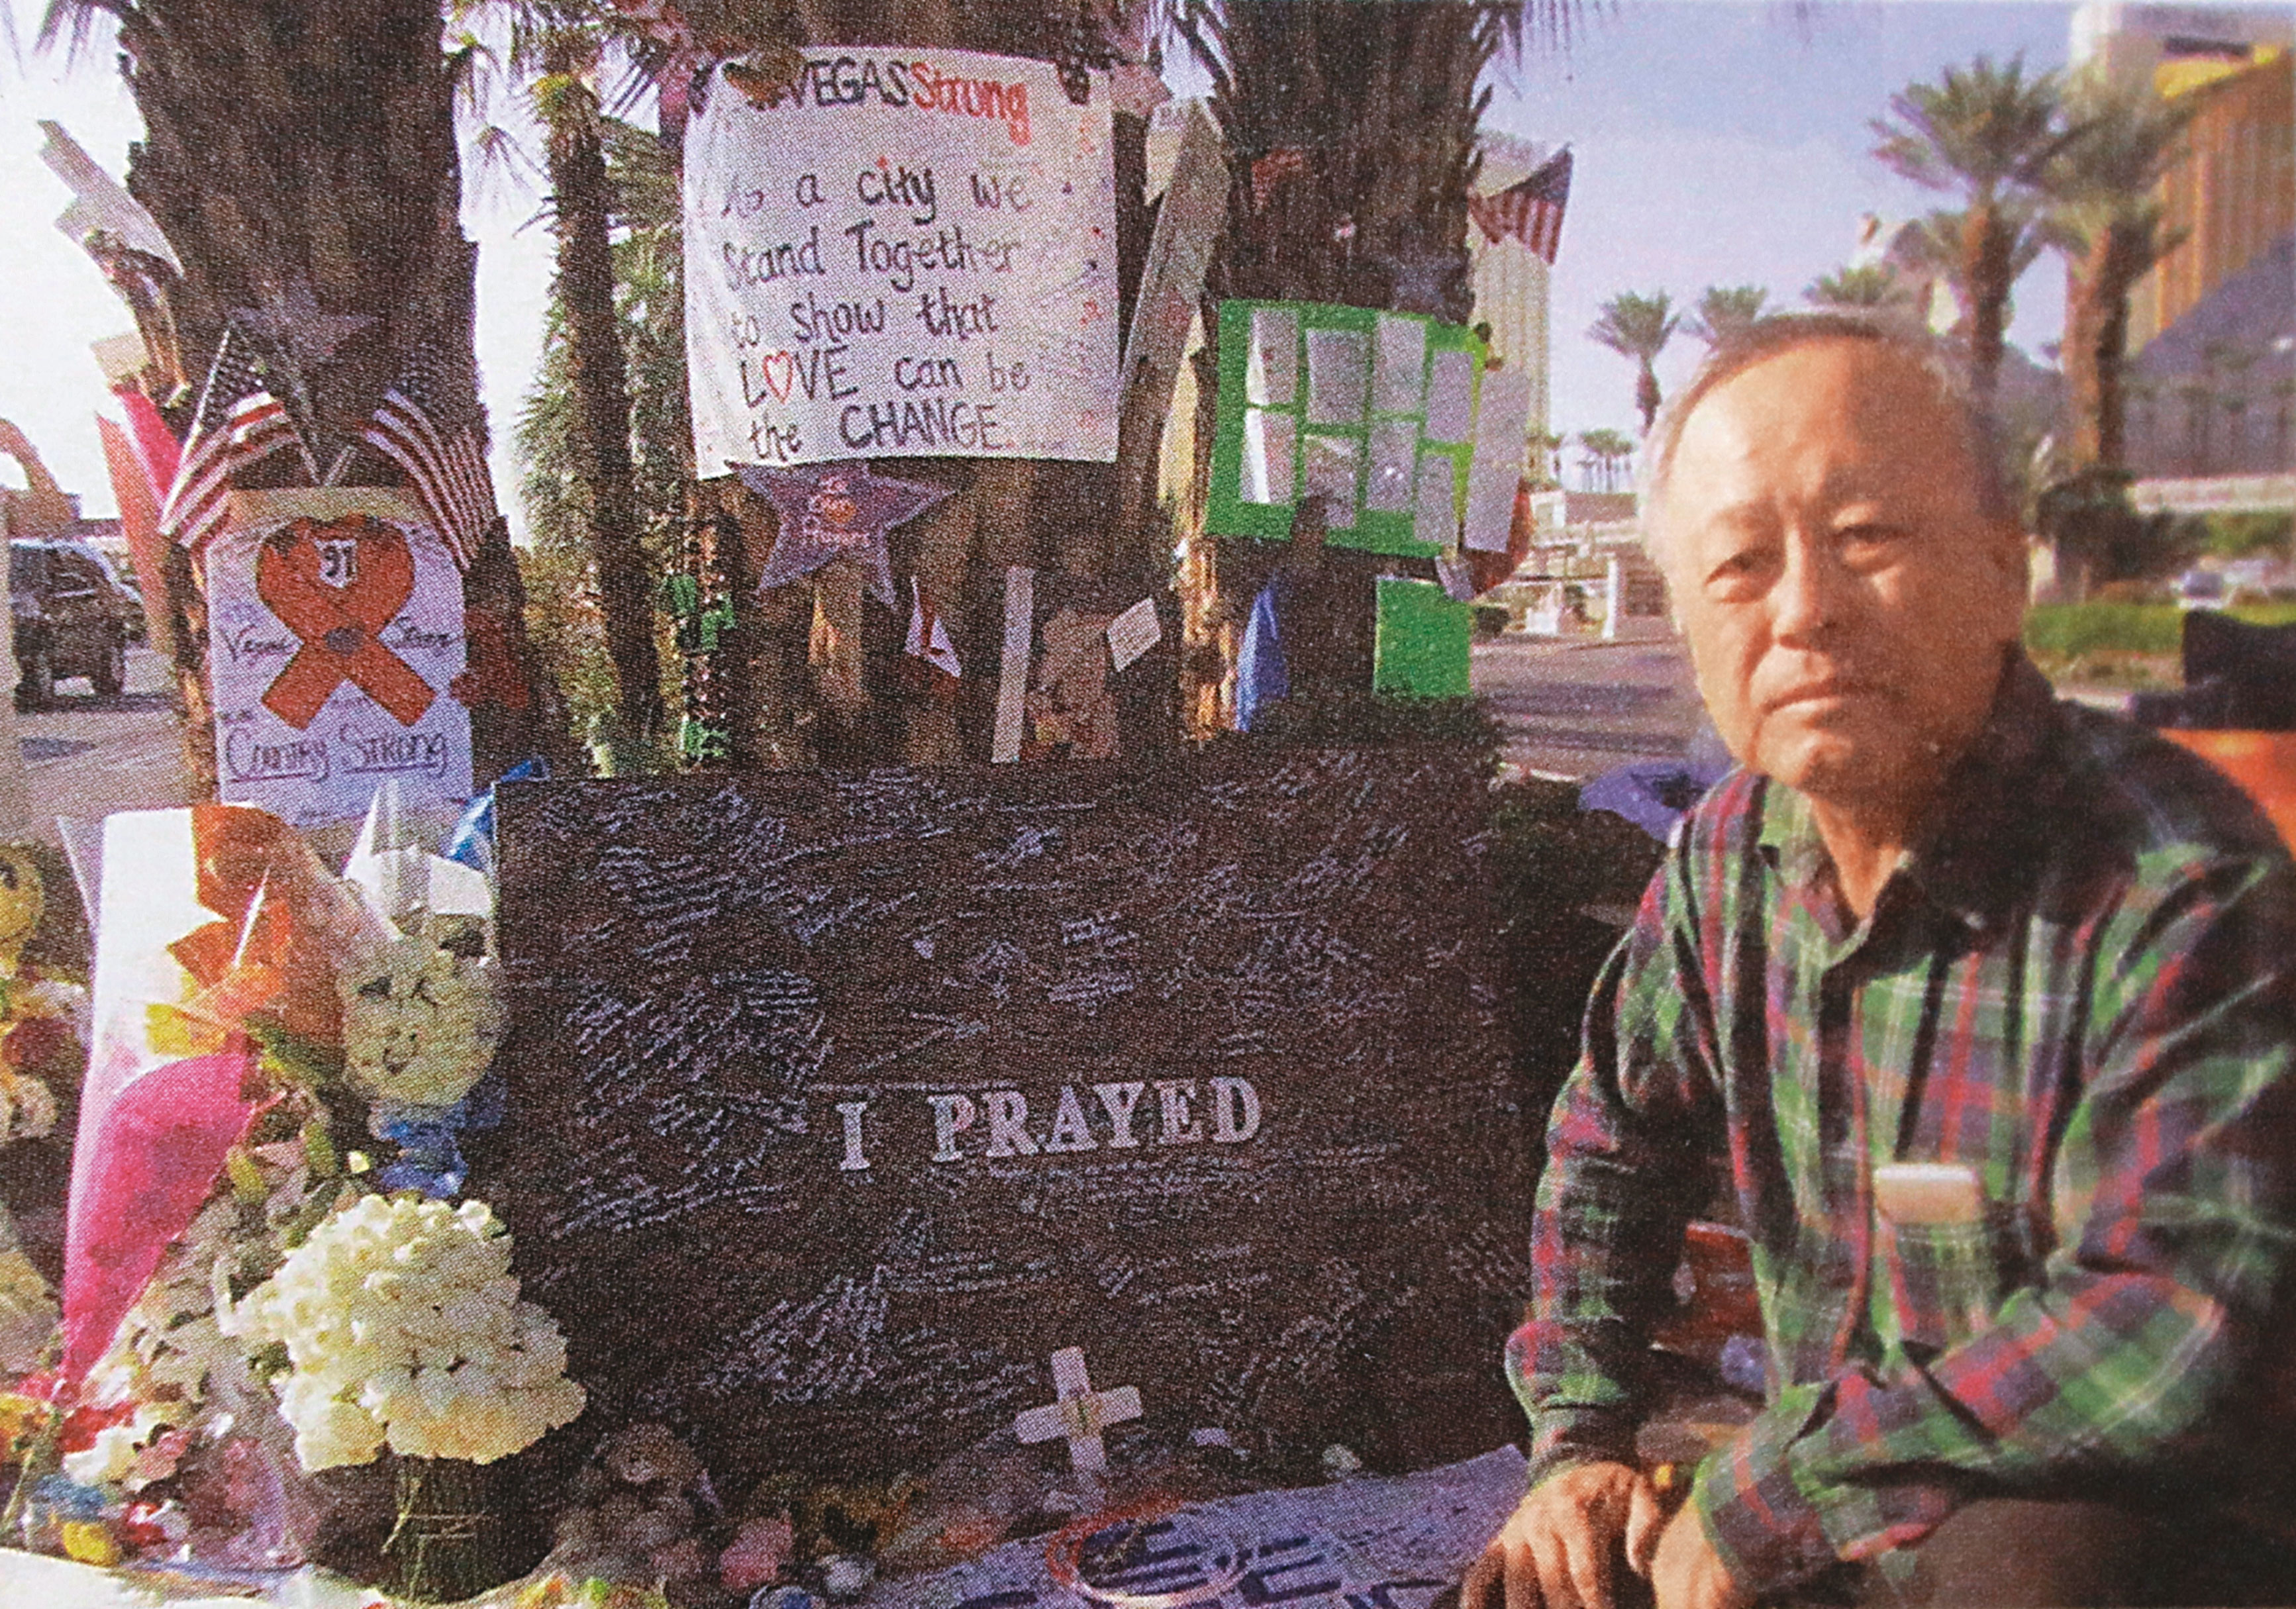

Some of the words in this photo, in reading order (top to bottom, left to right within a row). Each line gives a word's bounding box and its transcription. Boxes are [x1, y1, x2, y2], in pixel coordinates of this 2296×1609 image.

[796, 172, 825, 208] a
[857, 156, 936, 224] city
[970, 173, 1033, 211] we
[789, 292, 885, 344] show
[916, 287, 999, 340] that
[893, 357, 964, 391] can
[987, 353, 1030, 392] be
[748, 414, 803, 462] the
[836, 1100, 870, 1171] I
[927, 1075, 1262, 1163] PRAYED
